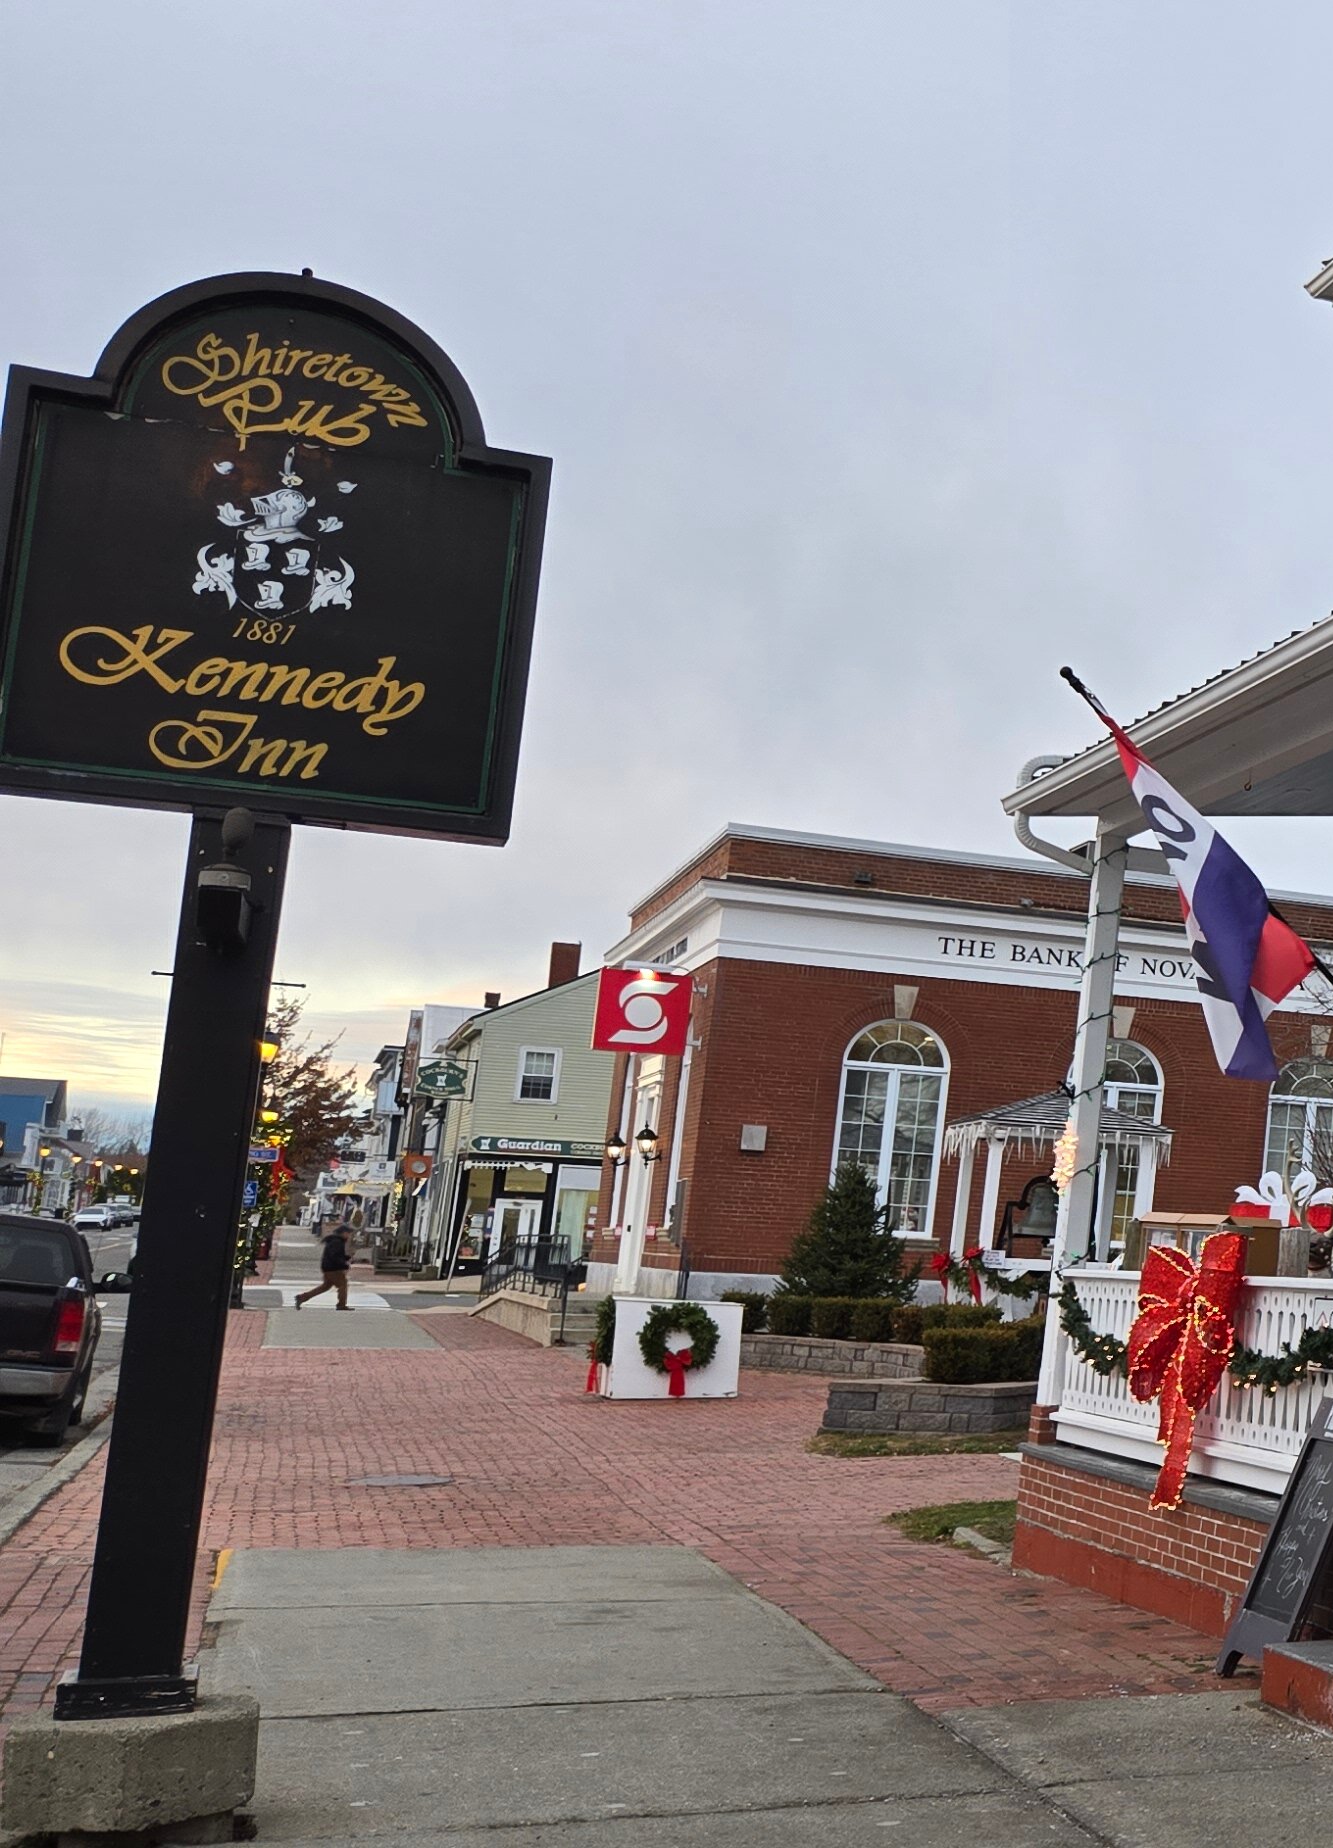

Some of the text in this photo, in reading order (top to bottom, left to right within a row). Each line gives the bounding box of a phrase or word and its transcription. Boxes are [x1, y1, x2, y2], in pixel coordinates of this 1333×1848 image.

[162, 332, 429, 429] Shiretown
[199, 377, 371, 452] Pub
[232, 617, 297, 647] 1881
[59, 624, 426, 736] Kennedy
[148, 709, 329, 780] Inn
[937, 936, 996, 960] THE
[1010, 944, 1083, 969] BANK
[497, 1138, 606, 1151] Guardian COCKBU
